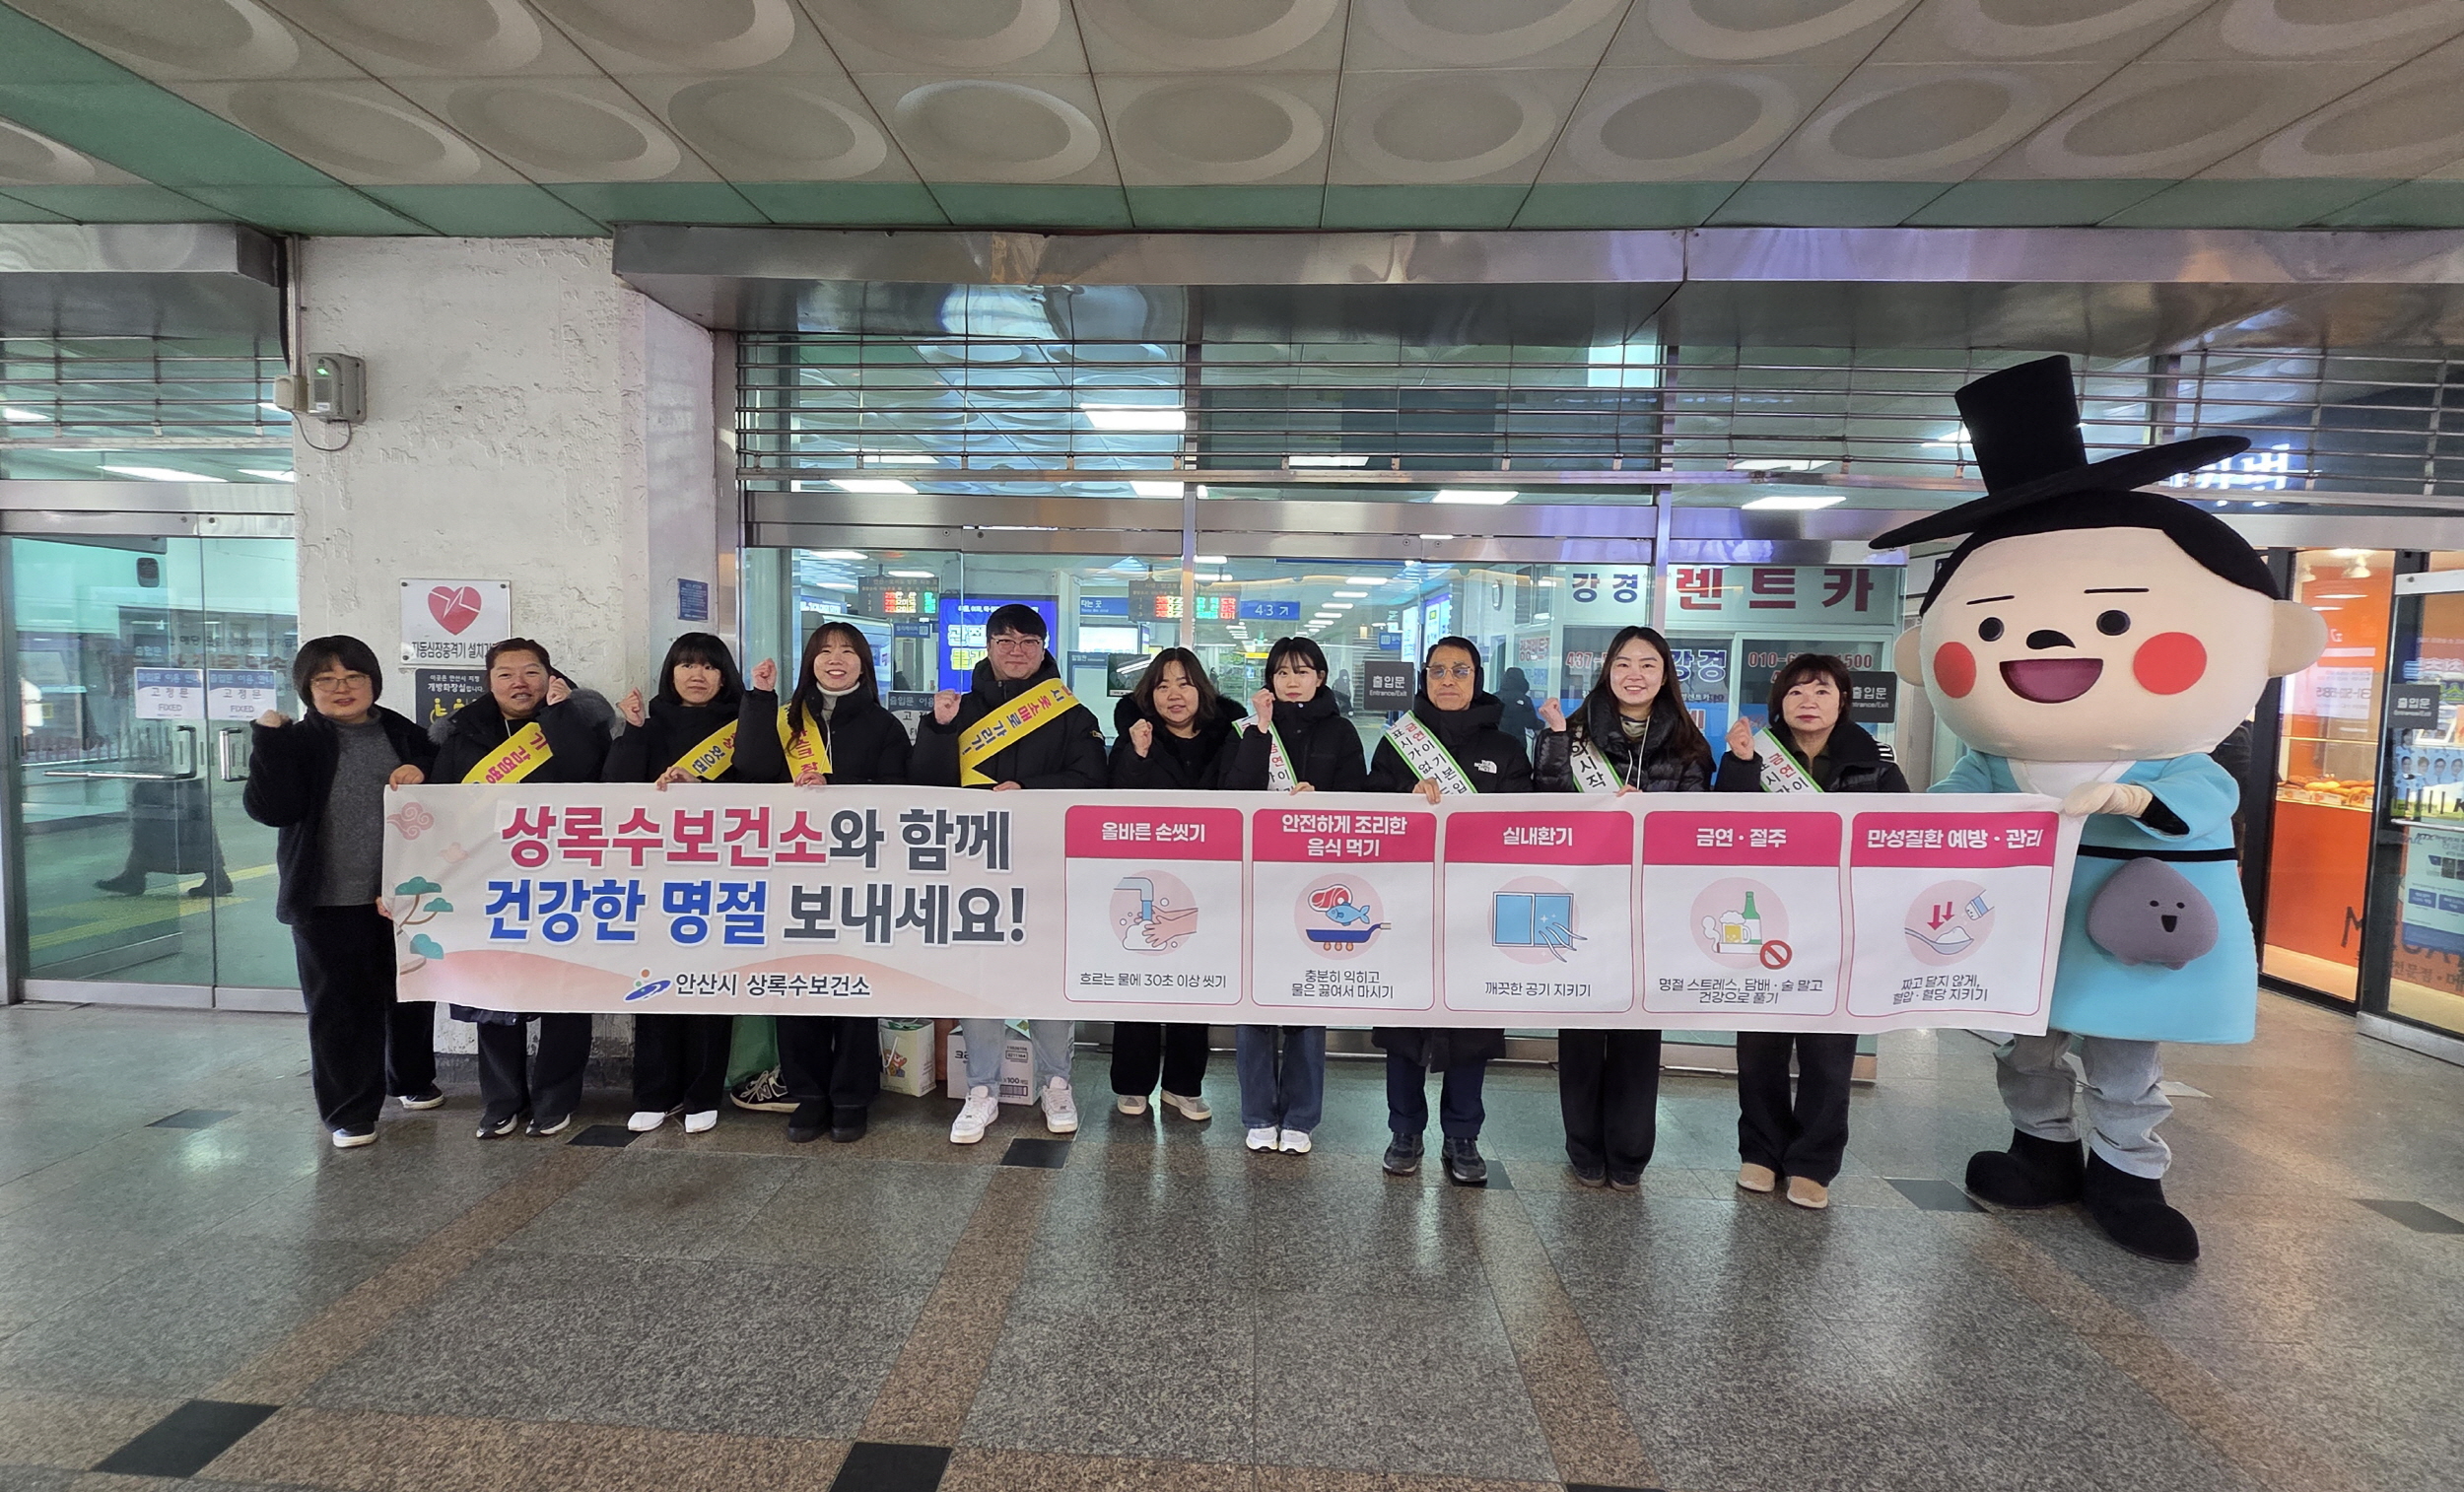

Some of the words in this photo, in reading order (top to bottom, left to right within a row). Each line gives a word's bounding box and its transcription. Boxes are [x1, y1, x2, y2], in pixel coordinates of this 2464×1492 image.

[1676, 568, 1875, 613] 렌트카
[411, 642, 466, 660] 자동심장충격기
[1372, 675, 1405, 689] 출입문
[1369, 689, 1407, 698] Entrance/Exit
[158, 703, 183, 712] FIXED
[230, 705, 255, 713] FIXED
[1006, 695, 1052, 729] 옷소매로
[2397, 697, 2431, 710] 출입문
[961, 720, 1007, 756] 가리기!
[1101, 822, 1152, 842] 올바른
[1155, 822, 1205, 844] 손씻기
[1281, 814, 1351, 835] 안전하게
[1354, 815, 1407, 837] 조리한
[502, 805, 885, 869] 상록수보건소와
[899, 808, 1010, 871] 함께
[1502, 826, 1573, 847] 실내환기
[1695, 827, 1734, 848] 금연
[1749, 828, 1787, 848] 절주
[1867, 829, 1944, 848] 만성질환
[1948, 829, 1988, 849] 예방
[2006, 829, 2044, 848] 관리
[1307, 838, 1342, 857] 음식
[1345, 839, 1381, 857] 먹기
[485, 879, 647, 942] 건강한
[662, 880, 767, 946] 명절
[783, 883, 1025, 945] 보내세요!
[675, 973, 737, 995] 안산시
[747, 974, 871, 997] 상록수보건소
[1079, 972, 1116, 986] 흐르는
[1118, 973, 1141, 987] 물에
[1143, 973, 1174, 987] 30초
[1177, 974, 1200, 987] 이상
[1202, 974, 1227, 988] 씻기
[1304, 969, 1340, 984] 충분히
[1343, 970, 1380, 984] 익히고
[1659, 978, 1684, 992] 명절
[1686, 978, 1742, 993] 스트레스,
[1744, 979, 1771, 992] 담배
[1781, 979, 1795, 992] 술
[1797, 979, 1823, 992] 말고
[1901, 977, 1923, 991] 짜고
[1925, 975, 1950, 988] 달지
[1951, 974, 1981, 988] 않게,
[1291, 983, 1316, 997] 물은
[1319, 983, 1355, 998] 끓여서
[1357, 984, 1395, 999] 마시기
[1484, 982, 1524, 996] 깨끗한
[1525, 982, 1550, 997] 공기
[1553, 983, 1592, 997] 지키기
[1698, 991, 1750, 1005] 건강으로
[1752, 991, 1779, 1005] 풀기
[1892, 991, 1914, 1006] 혈압
[1922, 988, 1947, 1002] 혈당
[1949, 988, 1988, 1002] 지키기
